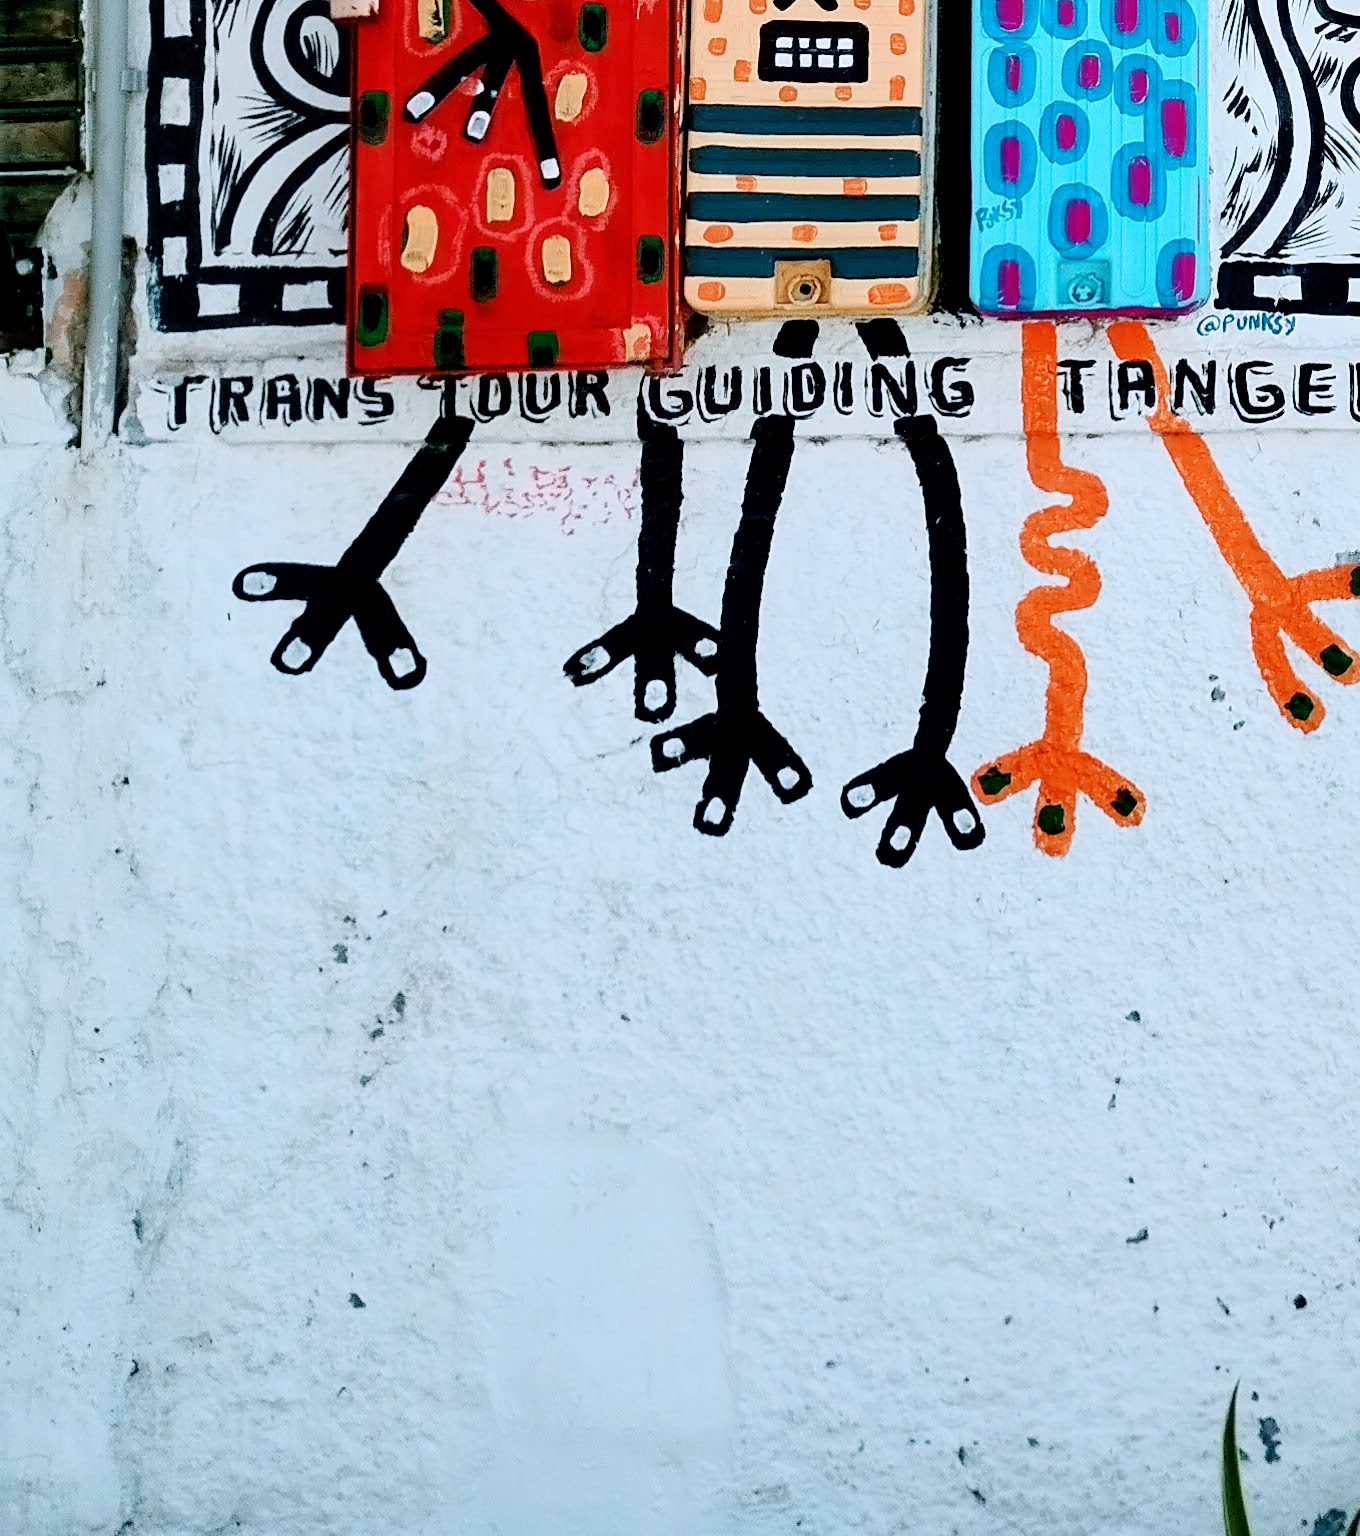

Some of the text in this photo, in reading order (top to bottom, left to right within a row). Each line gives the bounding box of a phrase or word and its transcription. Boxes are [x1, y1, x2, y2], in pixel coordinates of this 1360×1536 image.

[1196, 312, 1297, 337] @PUNKSY
[148, 372, 395, 434] TRANS
[418, 369, 612, 424] TOUR
[638, 355, 975, 427] GUIDING
